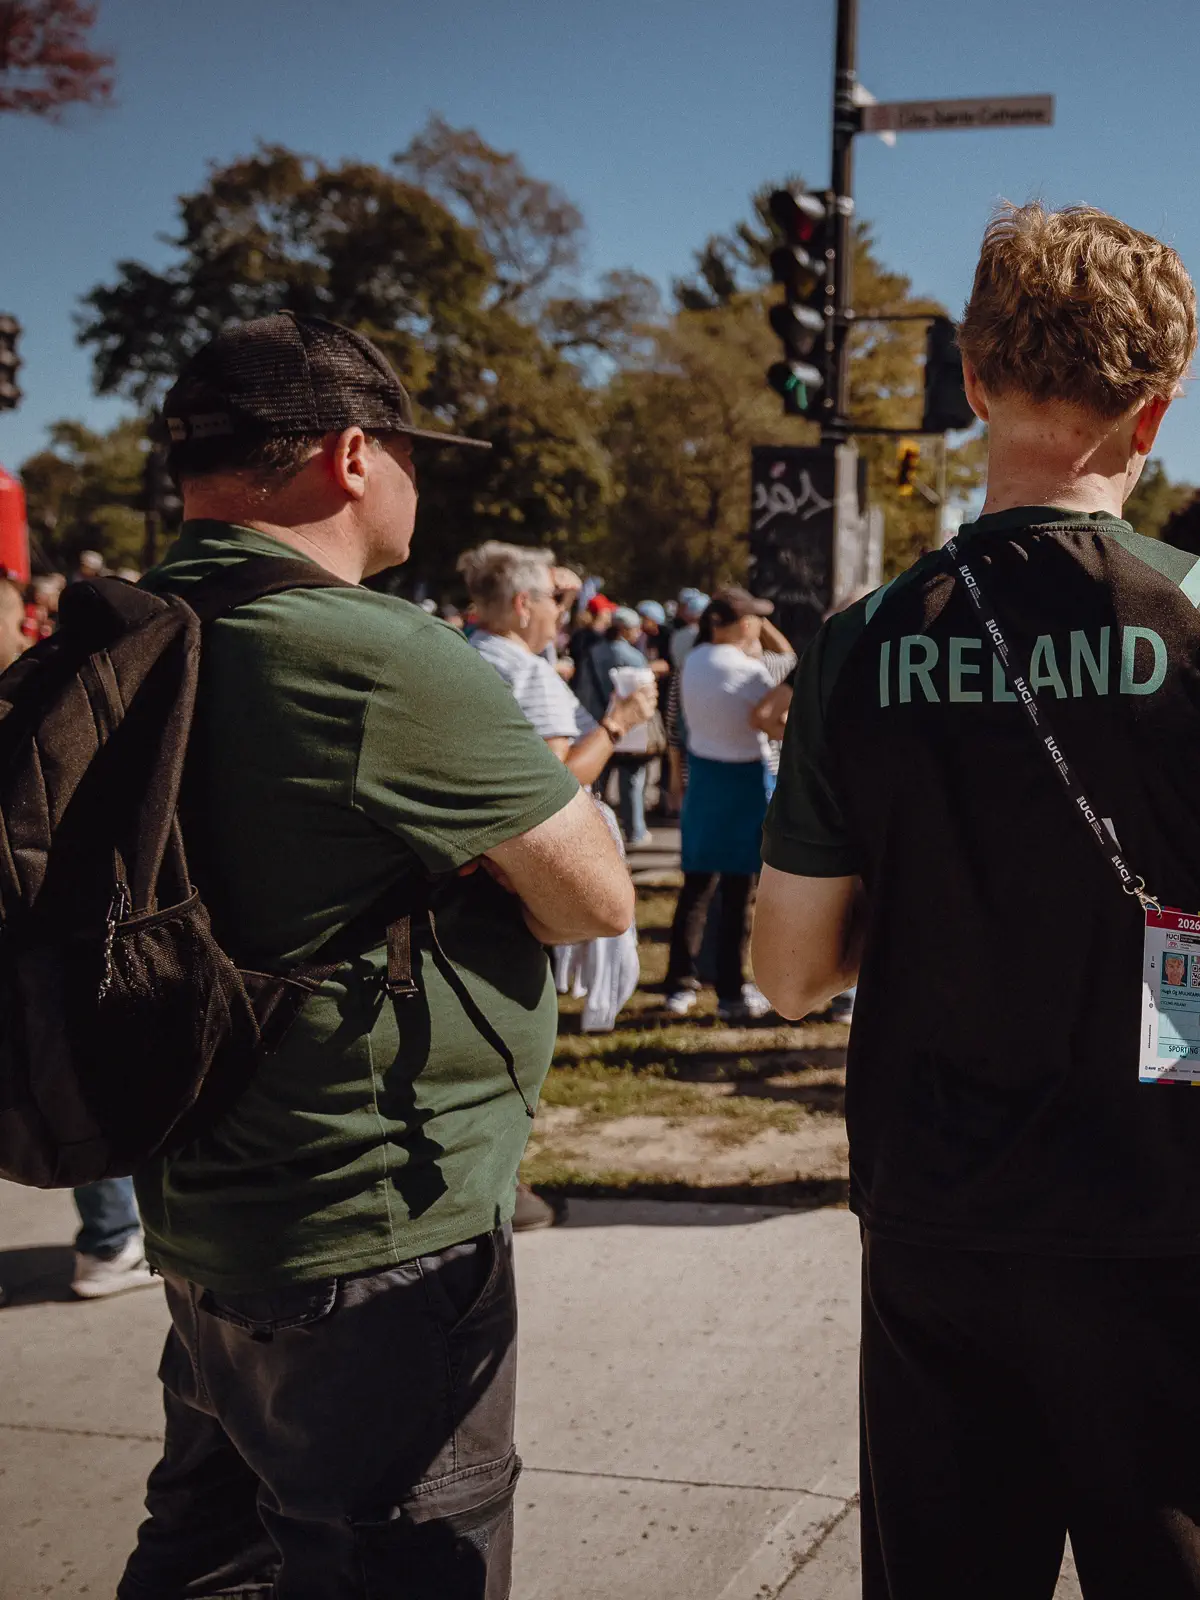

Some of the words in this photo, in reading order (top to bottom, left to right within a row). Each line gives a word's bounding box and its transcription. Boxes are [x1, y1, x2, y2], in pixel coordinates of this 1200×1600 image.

[961, 568, 977, 588] UCI
[988, 623, 1005, 646] UCI
[879, 625, 1168, 708] IRELAND
[1016, 681, 1033, 705] UCI
[1047, 740, 1064, 763] UCI
[1080, 800, 1097, 823] UCI
[1114, 859, 1132, 882] UCI
[1178, 918, 1200, 931] 2026
[1168, 1045, 1199, 1055] SPORTING
